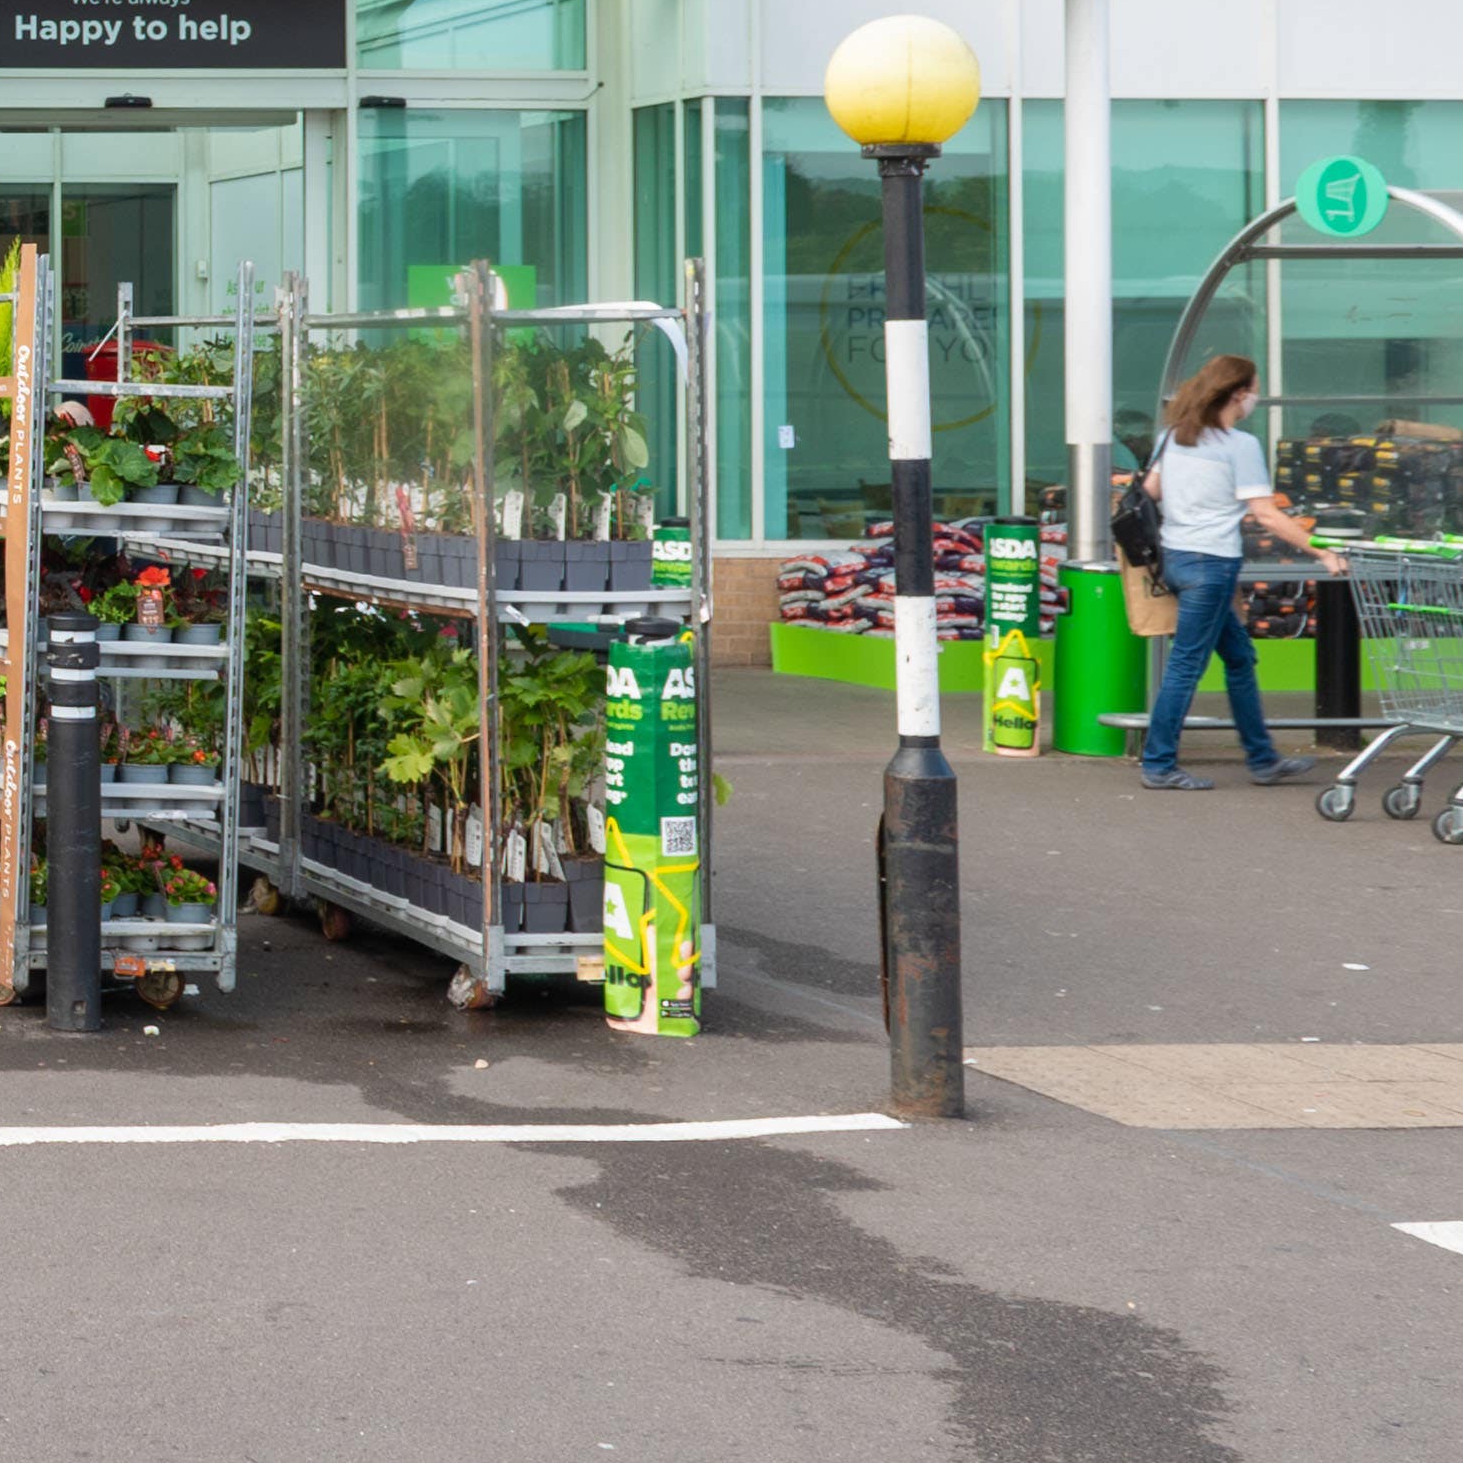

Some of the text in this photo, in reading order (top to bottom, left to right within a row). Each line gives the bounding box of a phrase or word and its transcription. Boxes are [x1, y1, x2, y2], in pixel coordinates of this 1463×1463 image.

[15, 13, 251, 46] Happy to help
[13, 344, 31, 504] Outdoor PLANTS
[653, 541, 692, 561] ASD
[2, 739, 18, 898] Outdoor PLANTS
